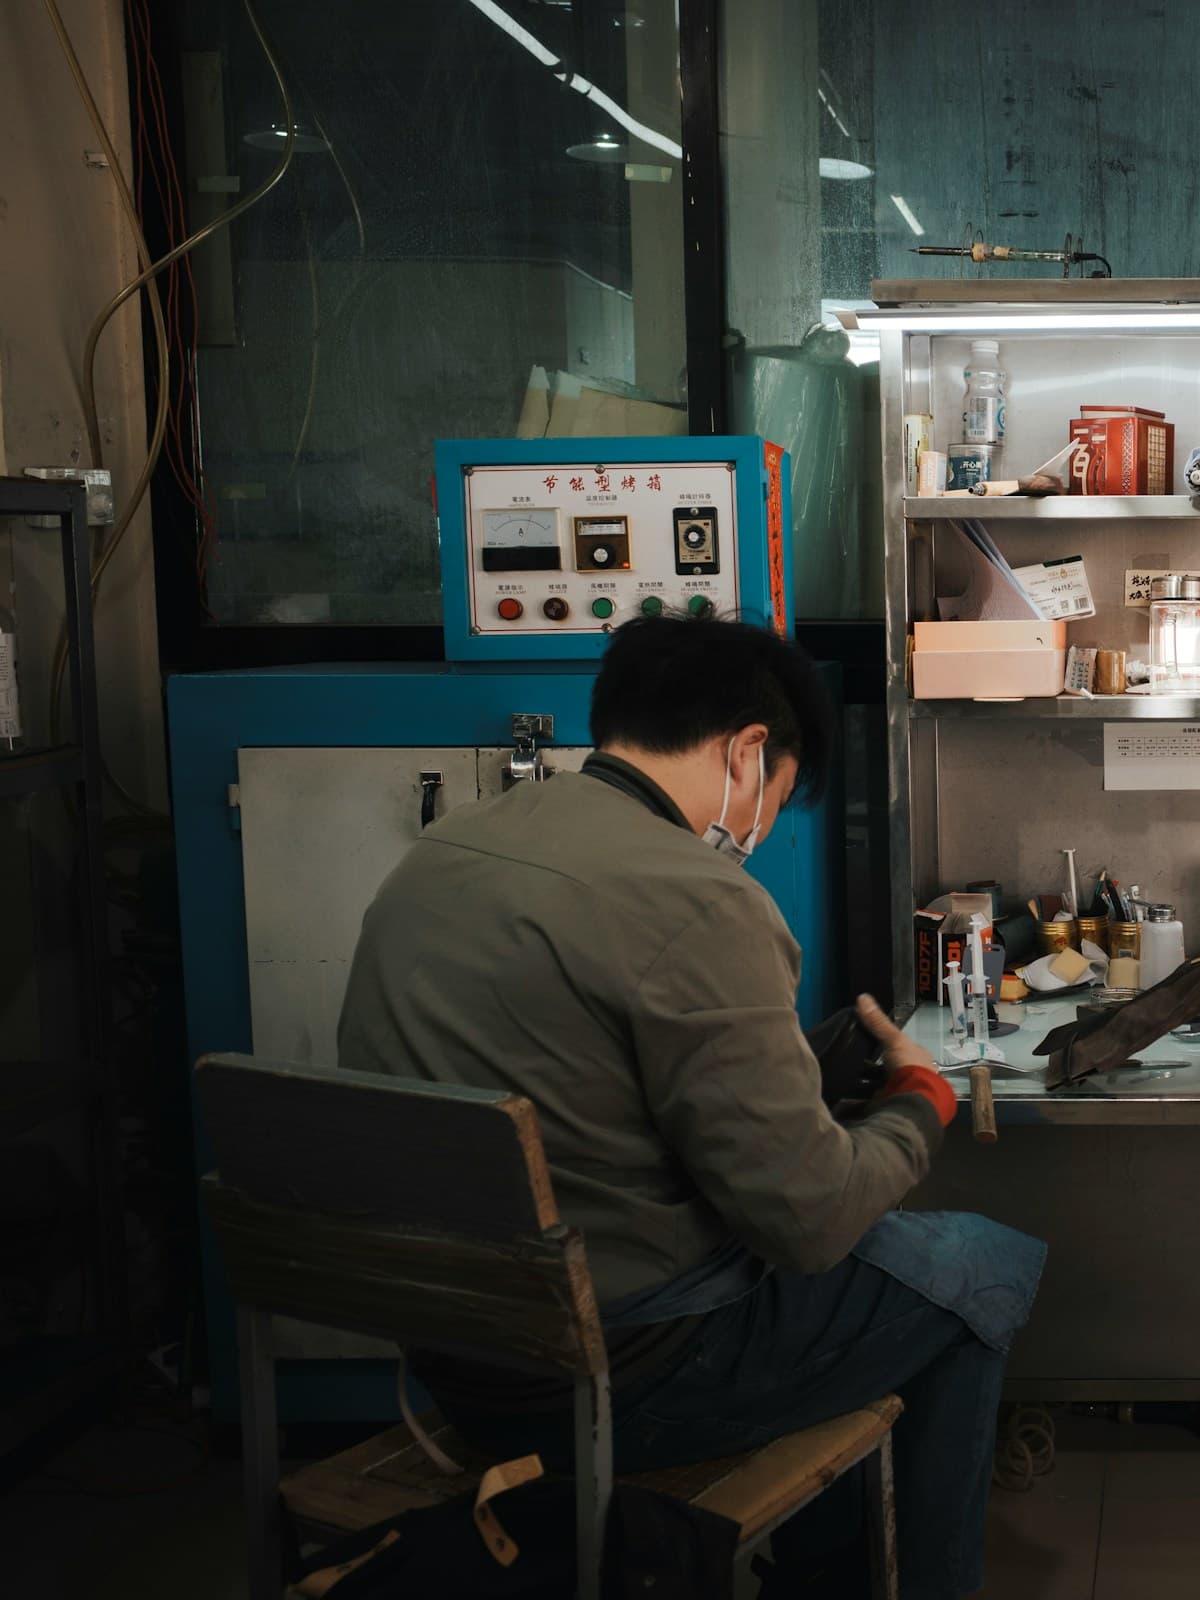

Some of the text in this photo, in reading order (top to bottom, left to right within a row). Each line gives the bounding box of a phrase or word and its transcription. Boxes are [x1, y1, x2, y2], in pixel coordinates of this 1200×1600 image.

[542, 474, 661, 494] 节能型烤箱
